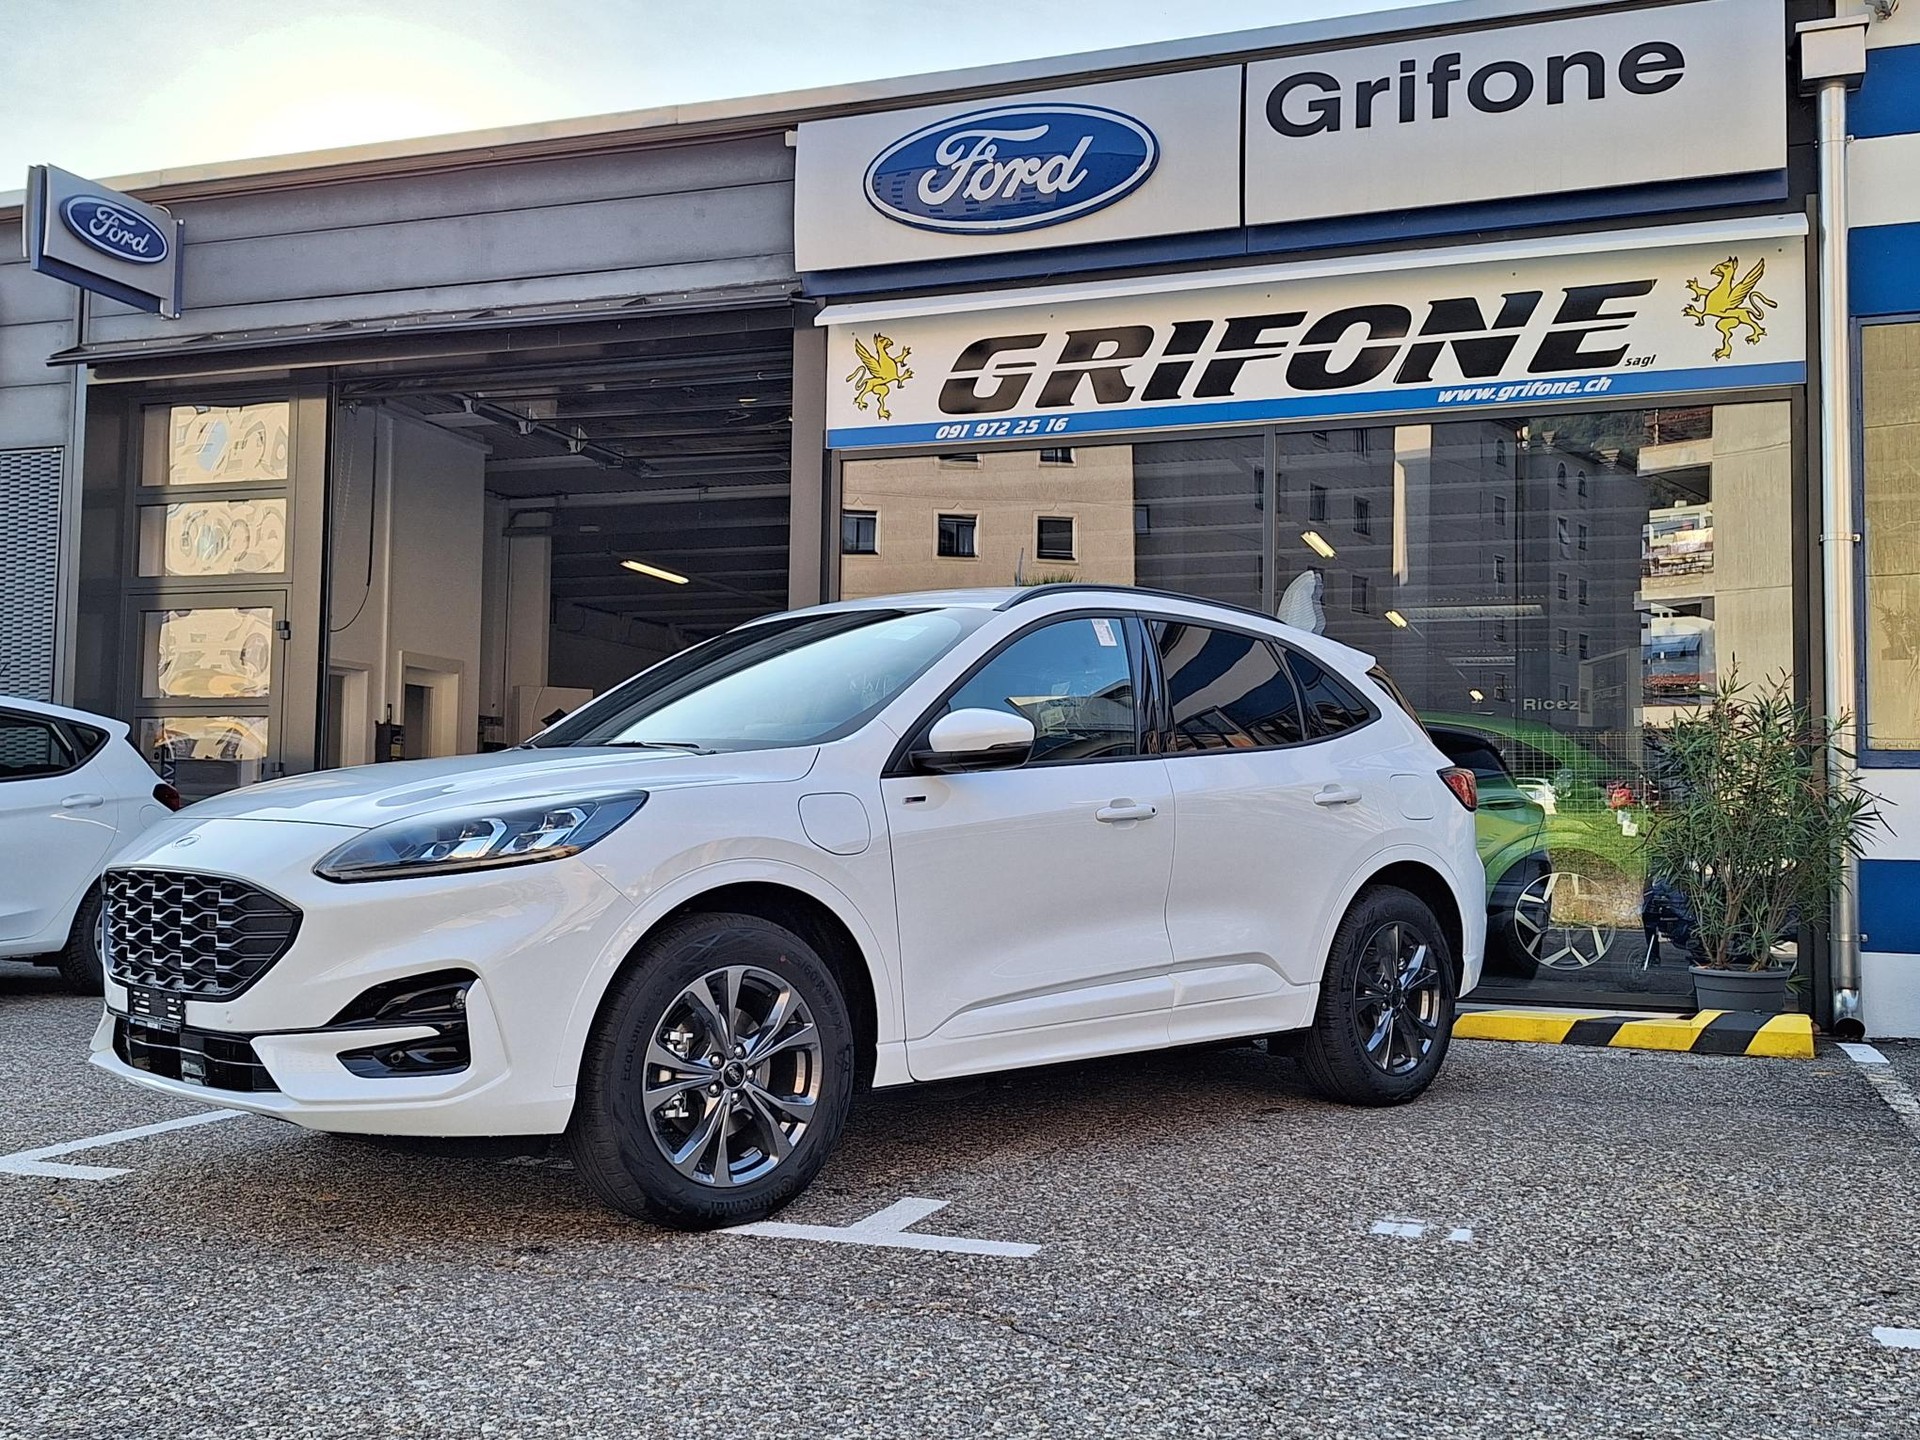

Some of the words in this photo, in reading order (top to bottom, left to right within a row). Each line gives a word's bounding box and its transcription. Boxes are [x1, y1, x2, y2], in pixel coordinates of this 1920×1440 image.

[1265, 41, 1686, 138] Grifone
[917, 124, 1093, 205] Ford
[89, 206, 151, 254] Ford
[939, 279, 1657, 415] GRIFONE
[1437, 377, 1612, 403] www.grifone.ch
[935, 424, 970, 440] 091
[974, 421, 1011, 438] 972
[1012, 419, 1041, 435] 25
[1045, 417, 1069, 433] 16
